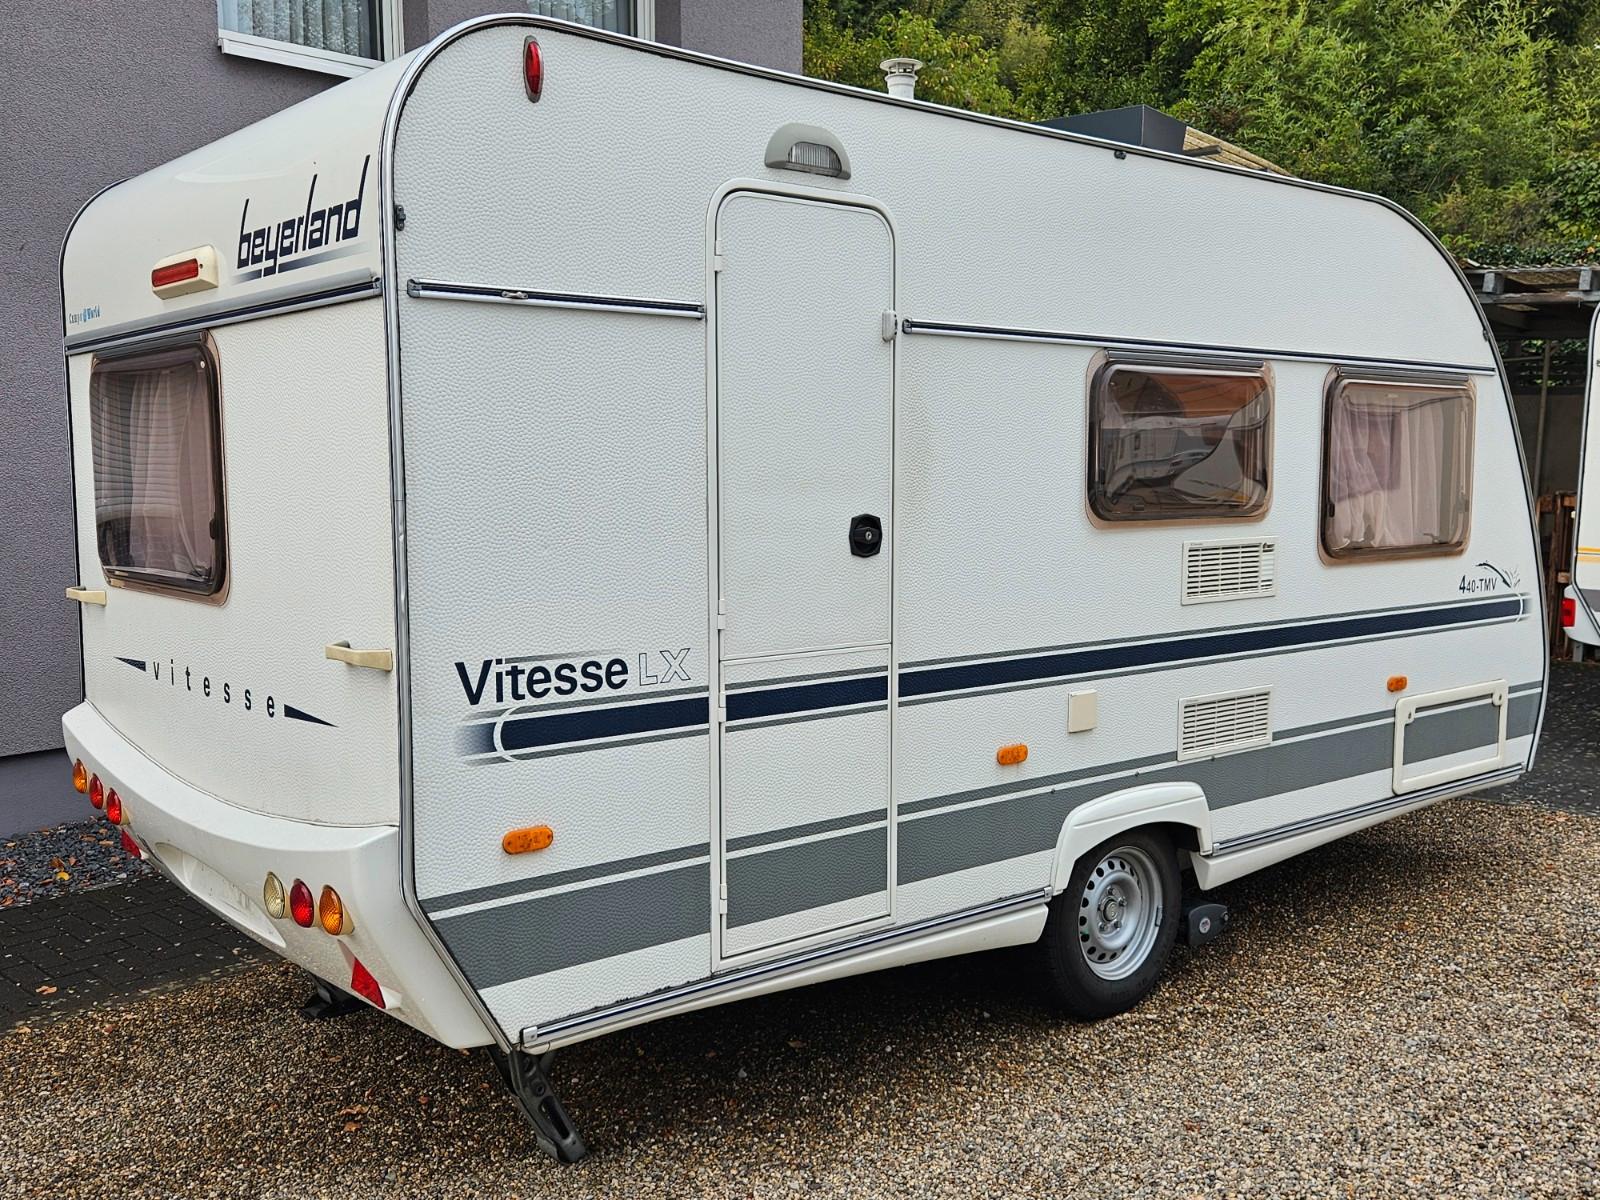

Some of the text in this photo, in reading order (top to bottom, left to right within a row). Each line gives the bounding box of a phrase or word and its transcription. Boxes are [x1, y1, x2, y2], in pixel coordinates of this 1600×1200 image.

[237, 155, 370, 277] beyerland
[153, 659, 275, 718] vitesse
[454, 647, 691, 705] Vitesse LX
